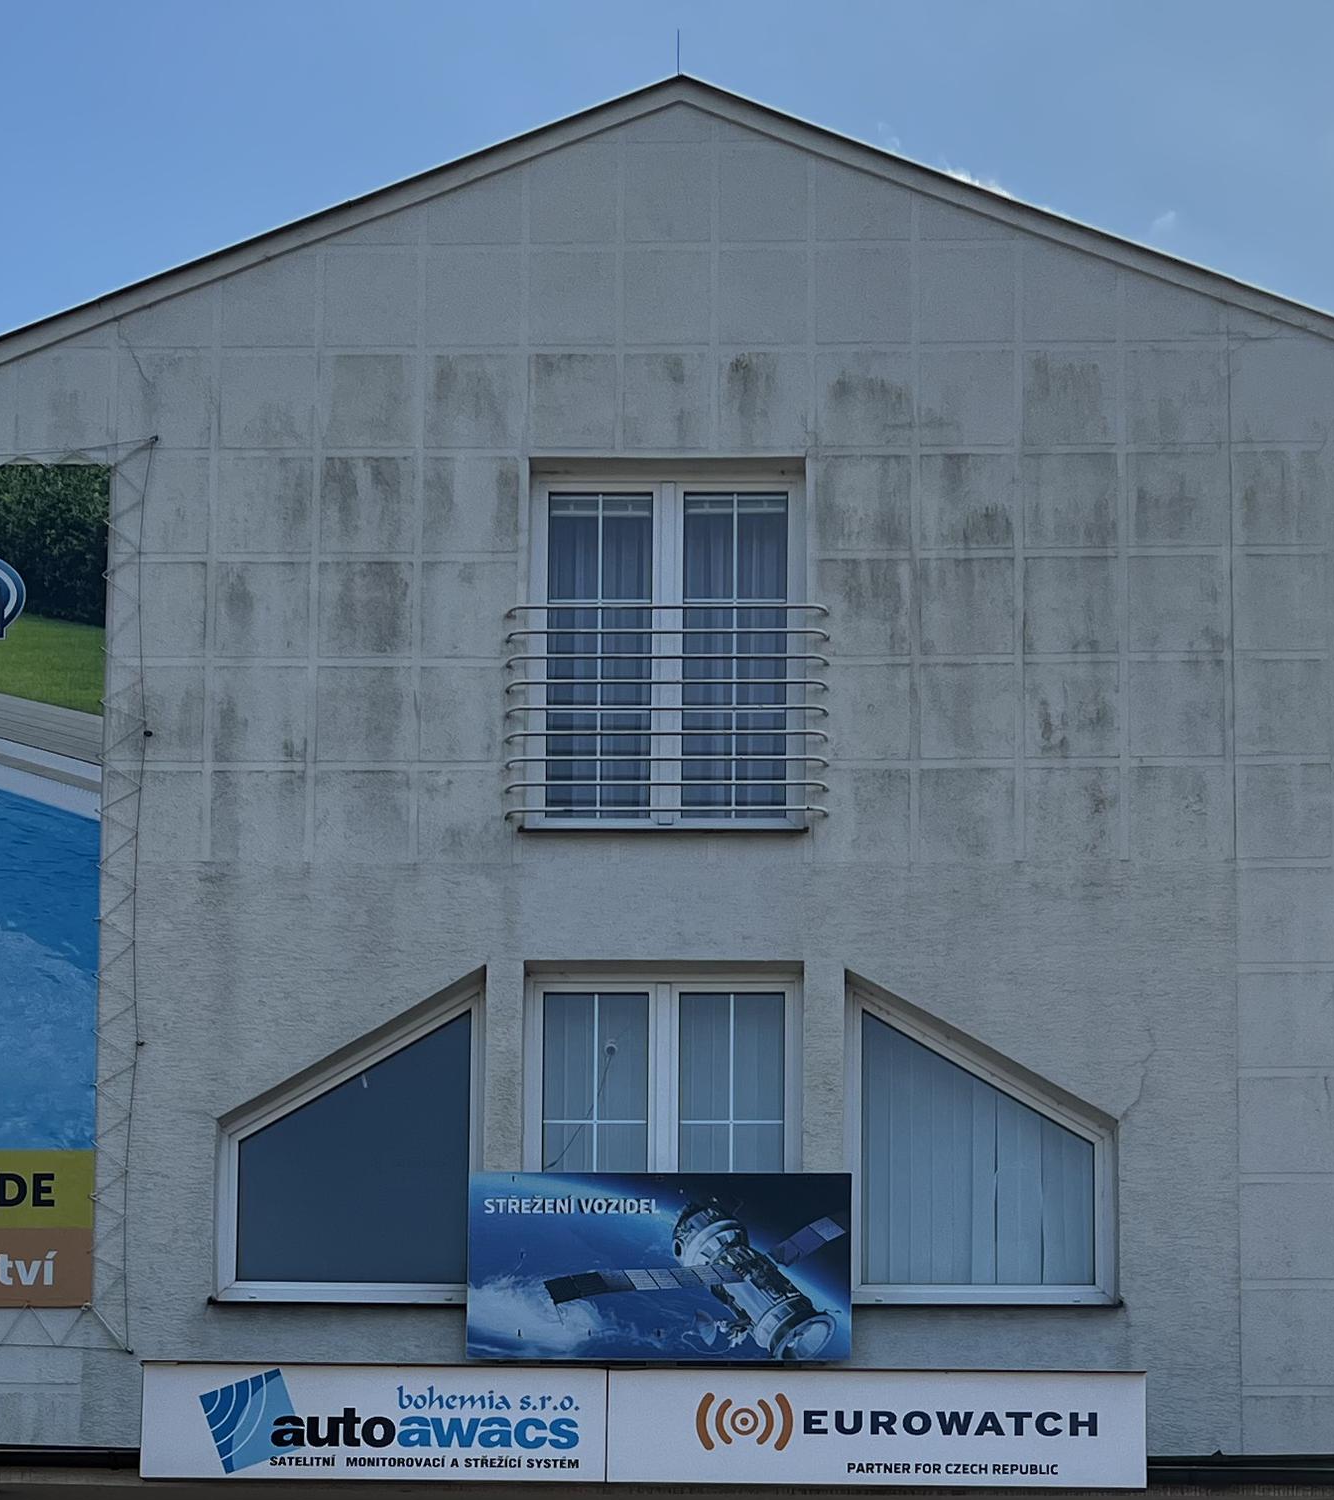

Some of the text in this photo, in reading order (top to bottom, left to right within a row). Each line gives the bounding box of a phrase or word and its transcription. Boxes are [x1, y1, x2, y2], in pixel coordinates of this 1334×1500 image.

[483, 1195, 660, 1214] STŘEŽENÍ VOZIDEL
[397, 1386, 580, 1411] bohemia s.r.o.
[804, 1410, 1099, 1437] EUROWATCH
[269, 1453, 580, 1469] SATELITNÍ MONITOROVACÍ A STŘEŽÍCÍ SYSTÉM
[847, 1462, 1059, 1476] PARTNER FOR CZECH REPUBLIC
